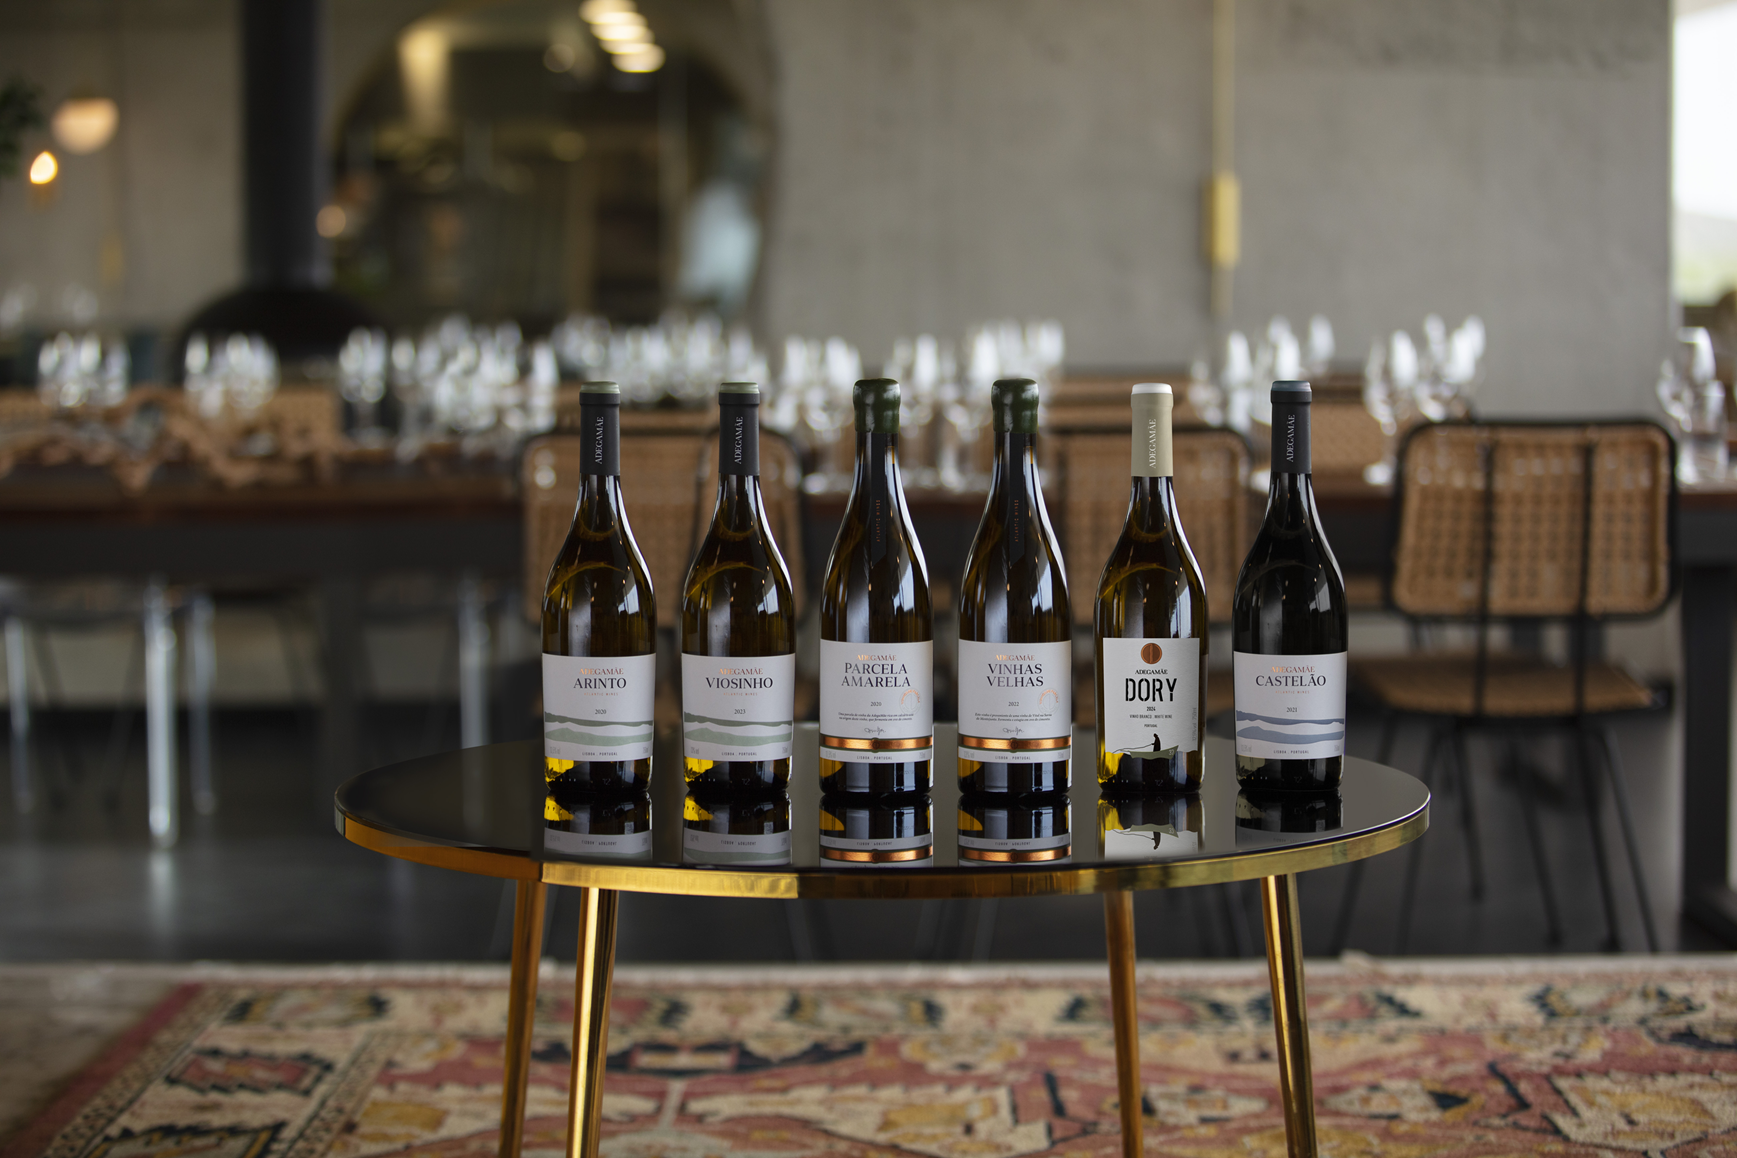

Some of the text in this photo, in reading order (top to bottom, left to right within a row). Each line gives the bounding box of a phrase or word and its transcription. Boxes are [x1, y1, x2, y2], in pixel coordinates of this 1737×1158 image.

[594, 416, 604, 465] ADEGAMÃE
[734, 416, 744, 465] ADEGAMÃE
[1148, 418, 1157, 469] ADEGAMÃE
[1286, 414, 1296, 462] ADEGAMÃE
[579, 667, 624, 675] ADEGAMÃE
[718, 667, 764, 675] ADEGAMÃE
[844, 662, 908, 675] PARCELA
[988, 663, 1043, 675] VINHAS
[1270, 665, 1315, 673] ADEGAMÃE
[573, 677, 627, 689] ARINTO
[705, 677, 774, 689] VIOSINHO
[841, 676, 911, 687] AMARELA
[986, 676, 1044, 687] VELHAS
[1255, 673, 1327, 686] CASTELÃO
[1125, 678, 1177, 702] DORY
